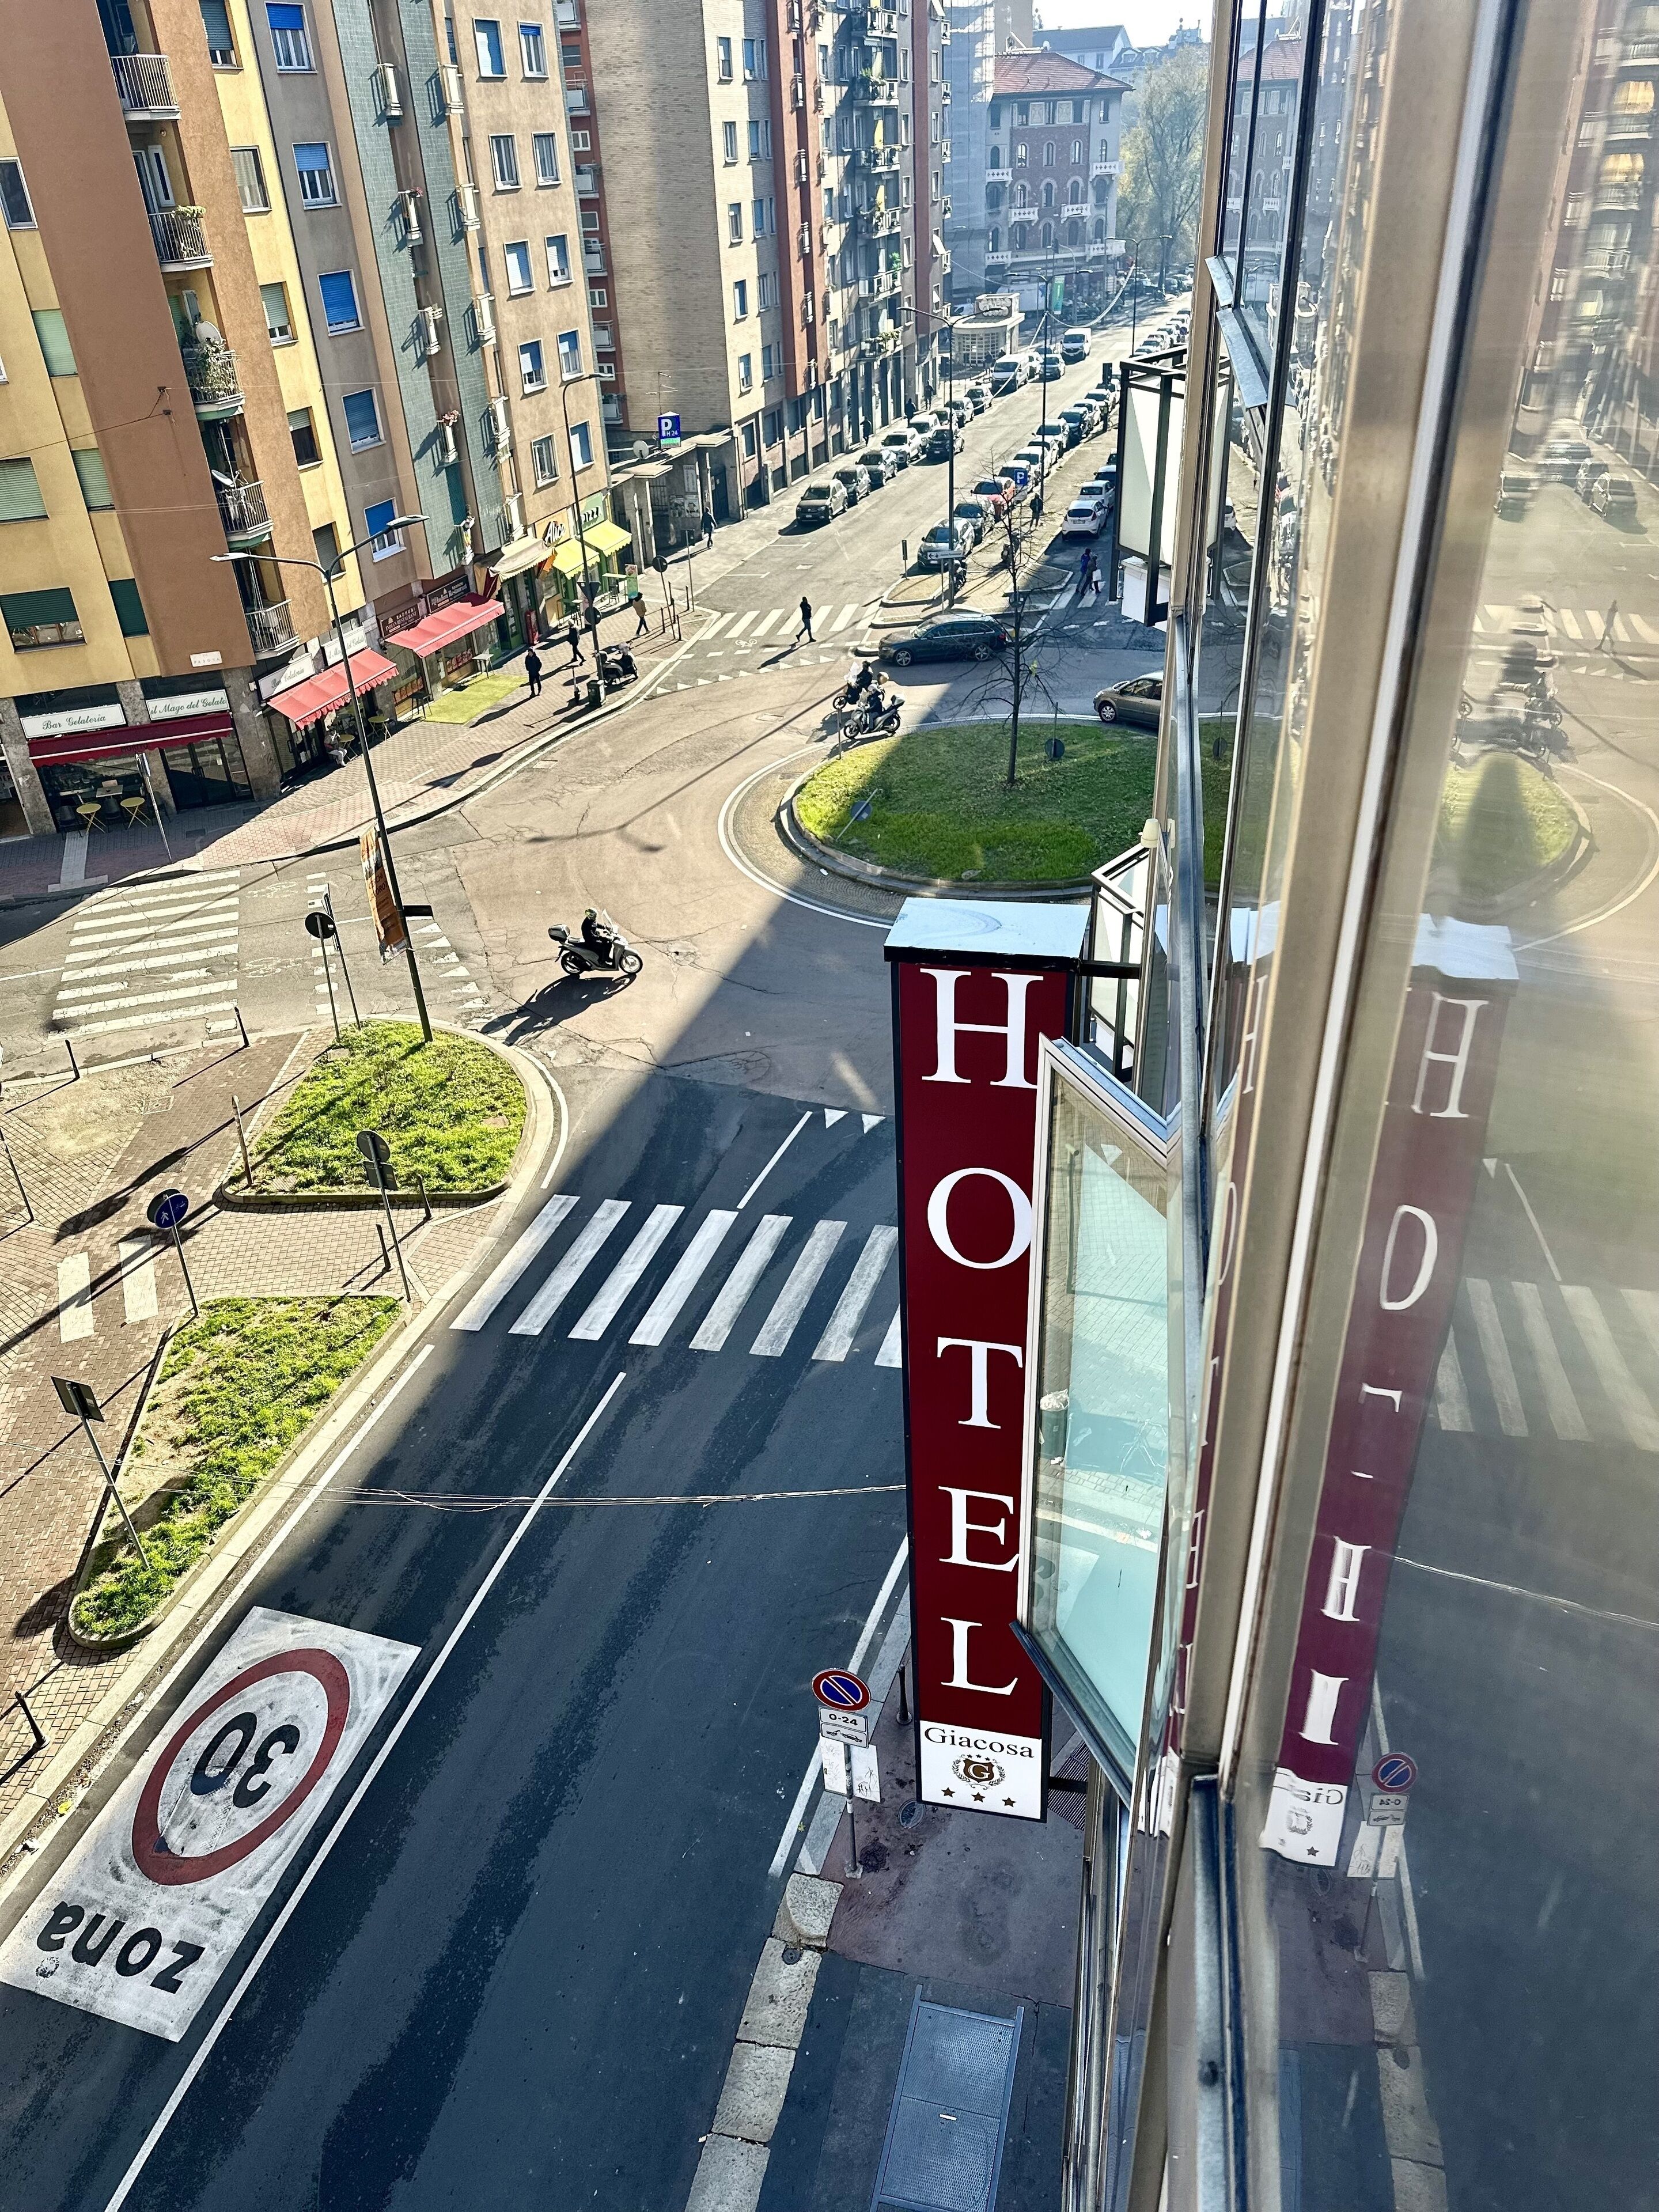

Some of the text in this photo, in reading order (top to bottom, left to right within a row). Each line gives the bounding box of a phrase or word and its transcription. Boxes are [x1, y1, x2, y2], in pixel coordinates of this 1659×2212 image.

[661, 418, 672, 437] P
[1017, 471, 1025, 483] P
[159, 704, 184, 715] Mago
[186, 699, 199, 710] del
[201, 696, 226, 707] Gelato
[42, 714, 106, 730] Bar Gelateria
[919, 968, 1043, 1696] HOTEL
[828, 1713, 858, 1726] 0-24
[924, 1726, 1035, 1759] Giacosa
[190, 1711, 300, 1808] 30
[36, 1901, 206, 1994] zona
